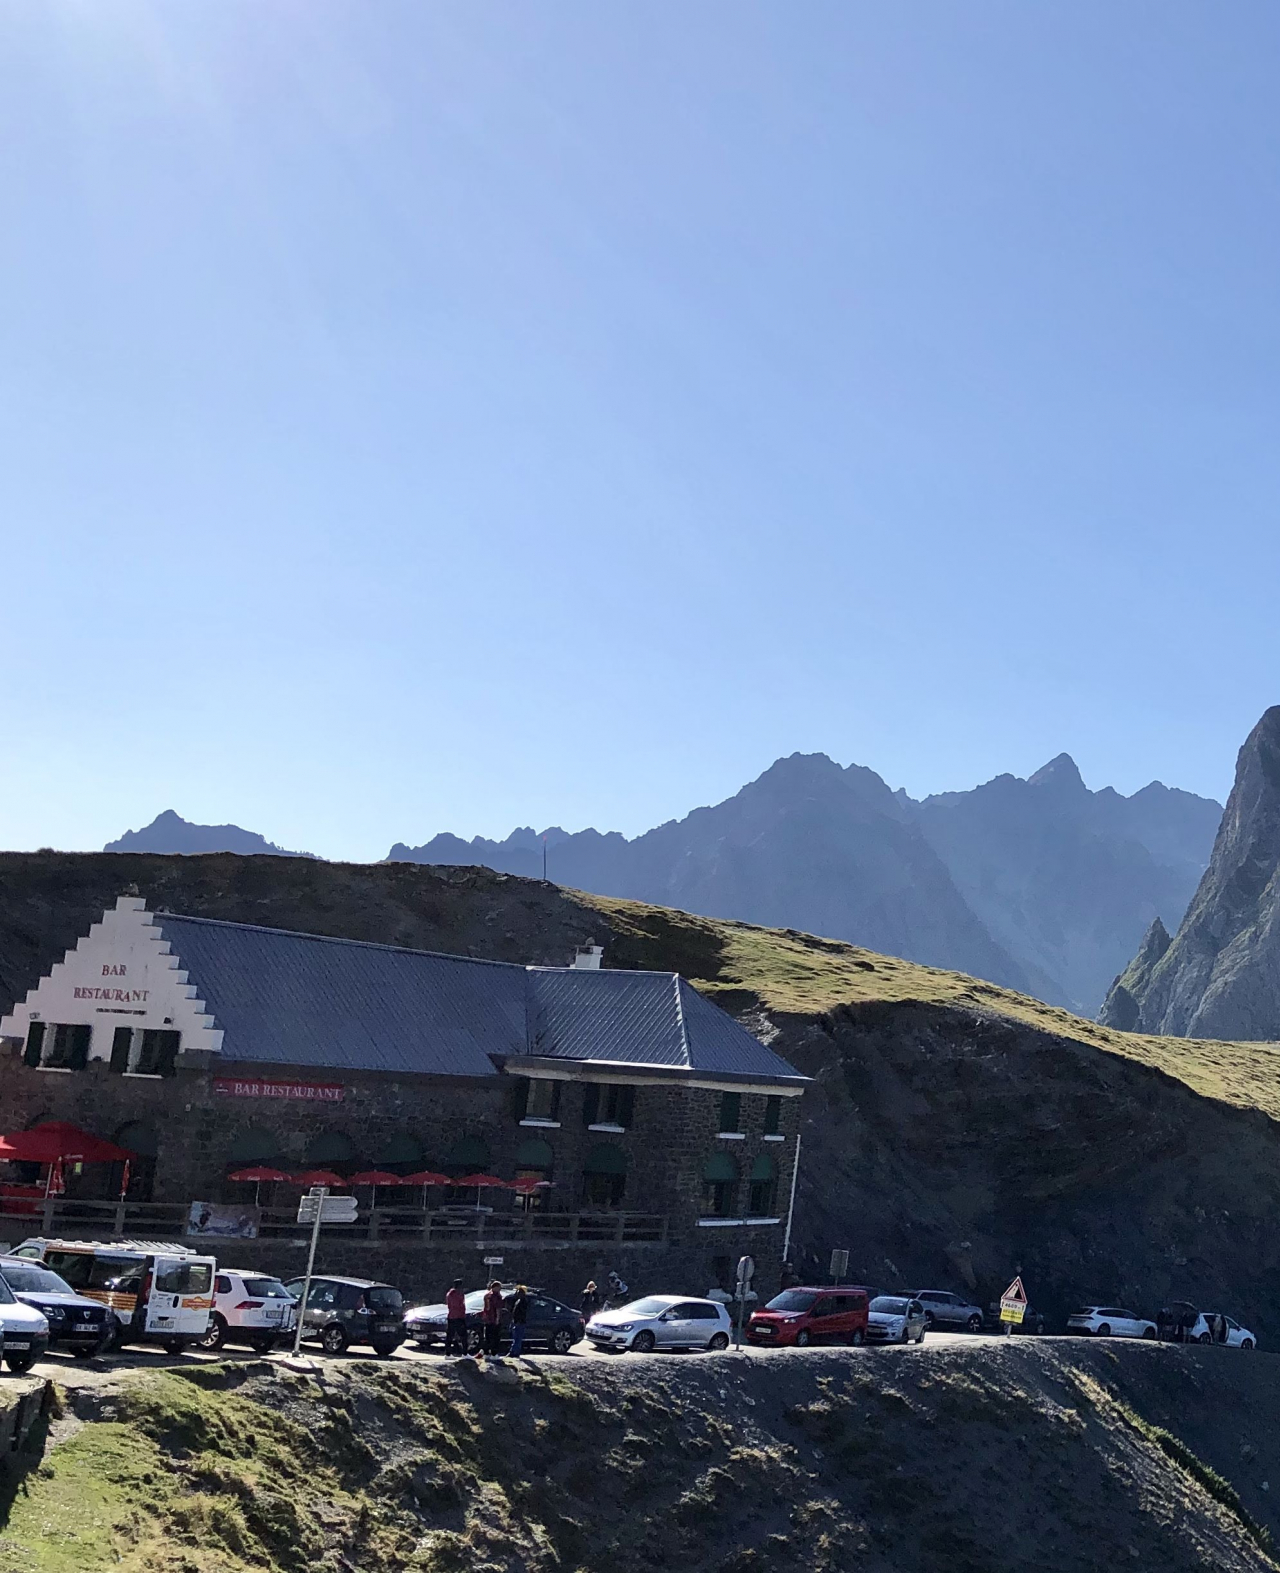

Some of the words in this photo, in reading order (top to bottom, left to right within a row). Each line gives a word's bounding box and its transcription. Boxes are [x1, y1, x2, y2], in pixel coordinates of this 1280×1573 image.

[102, 964, 126, 976] BAR
[73, 987, 149, 1002] RESTAURANT
[234, 1083, 259, 1095] BAR
[263, 1084, 341, 1099] RESTAURANT
